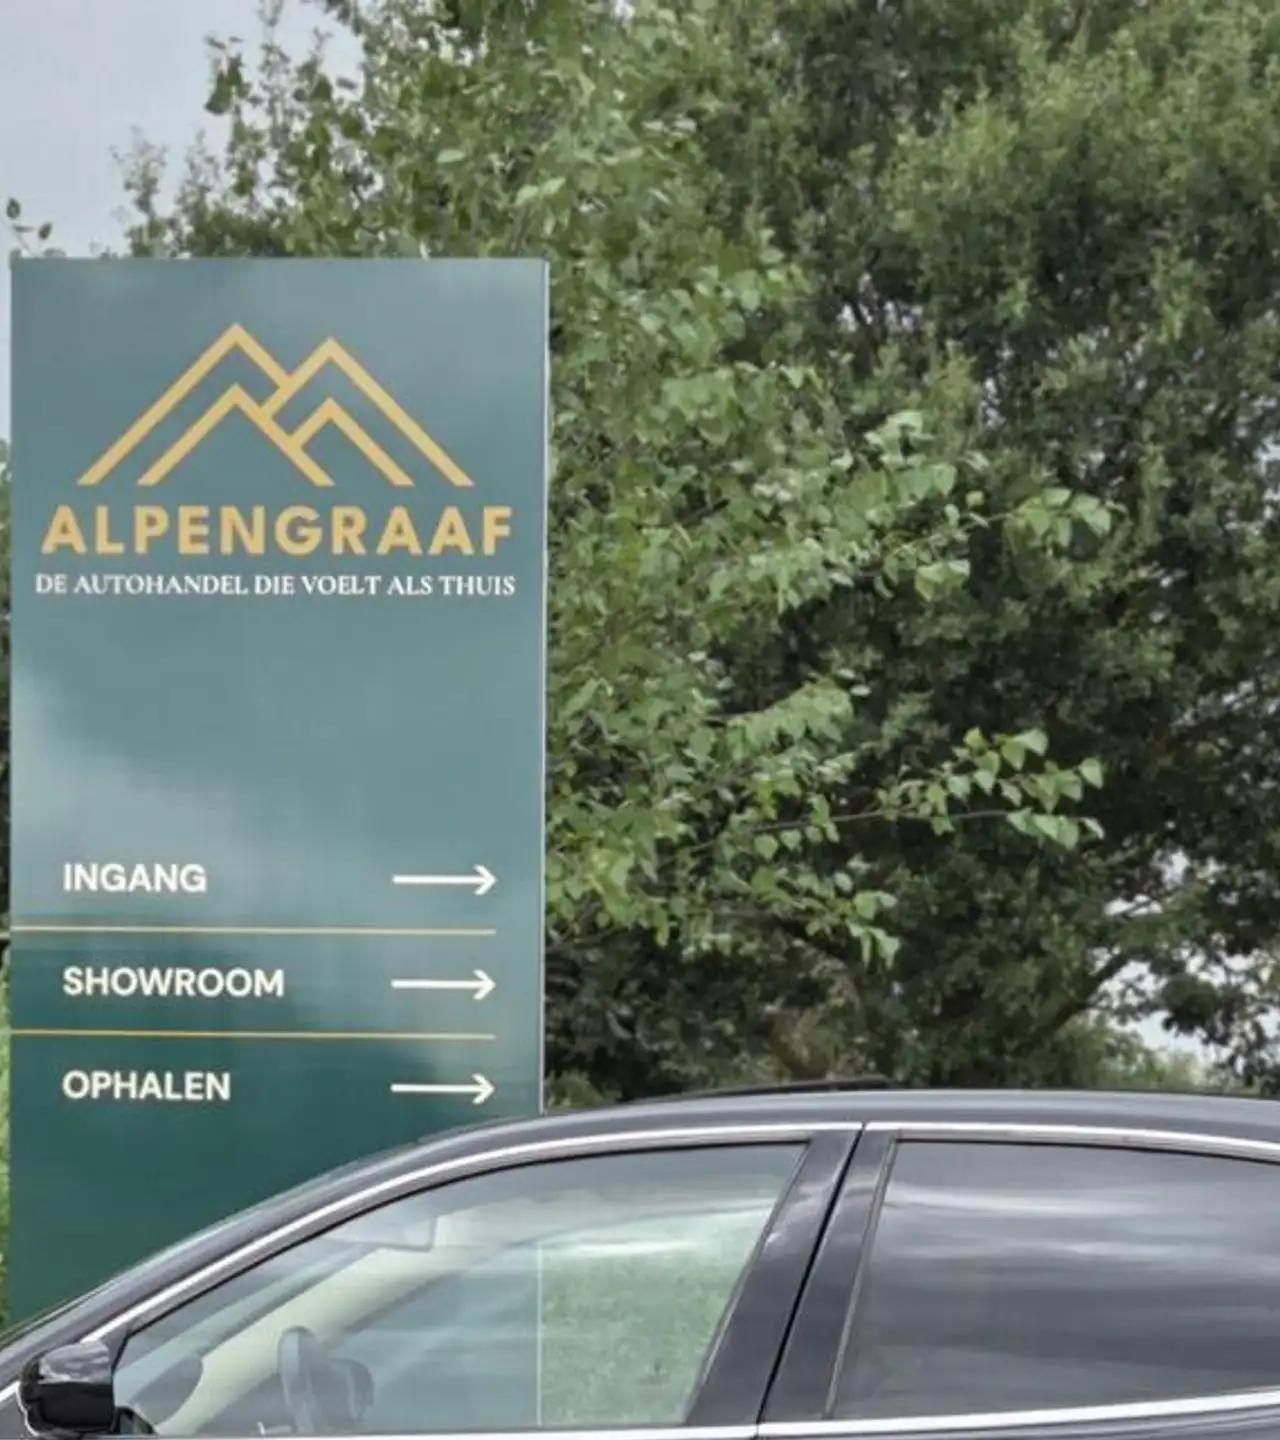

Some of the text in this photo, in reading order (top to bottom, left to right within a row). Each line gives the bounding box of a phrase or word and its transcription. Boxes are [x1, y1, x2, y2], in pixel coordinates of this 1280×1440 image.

[41, 504, 512, 556] ALPENGRAAF
[35, 573, 516, 597] DE AUTOHANDEL DIE VOELT ALS THUIS
[63, 863, 207, 893] INGANG
[63, 967, 285, 998] SHOWROOM
[62, 1070, 231, 1101] OPHALEN
